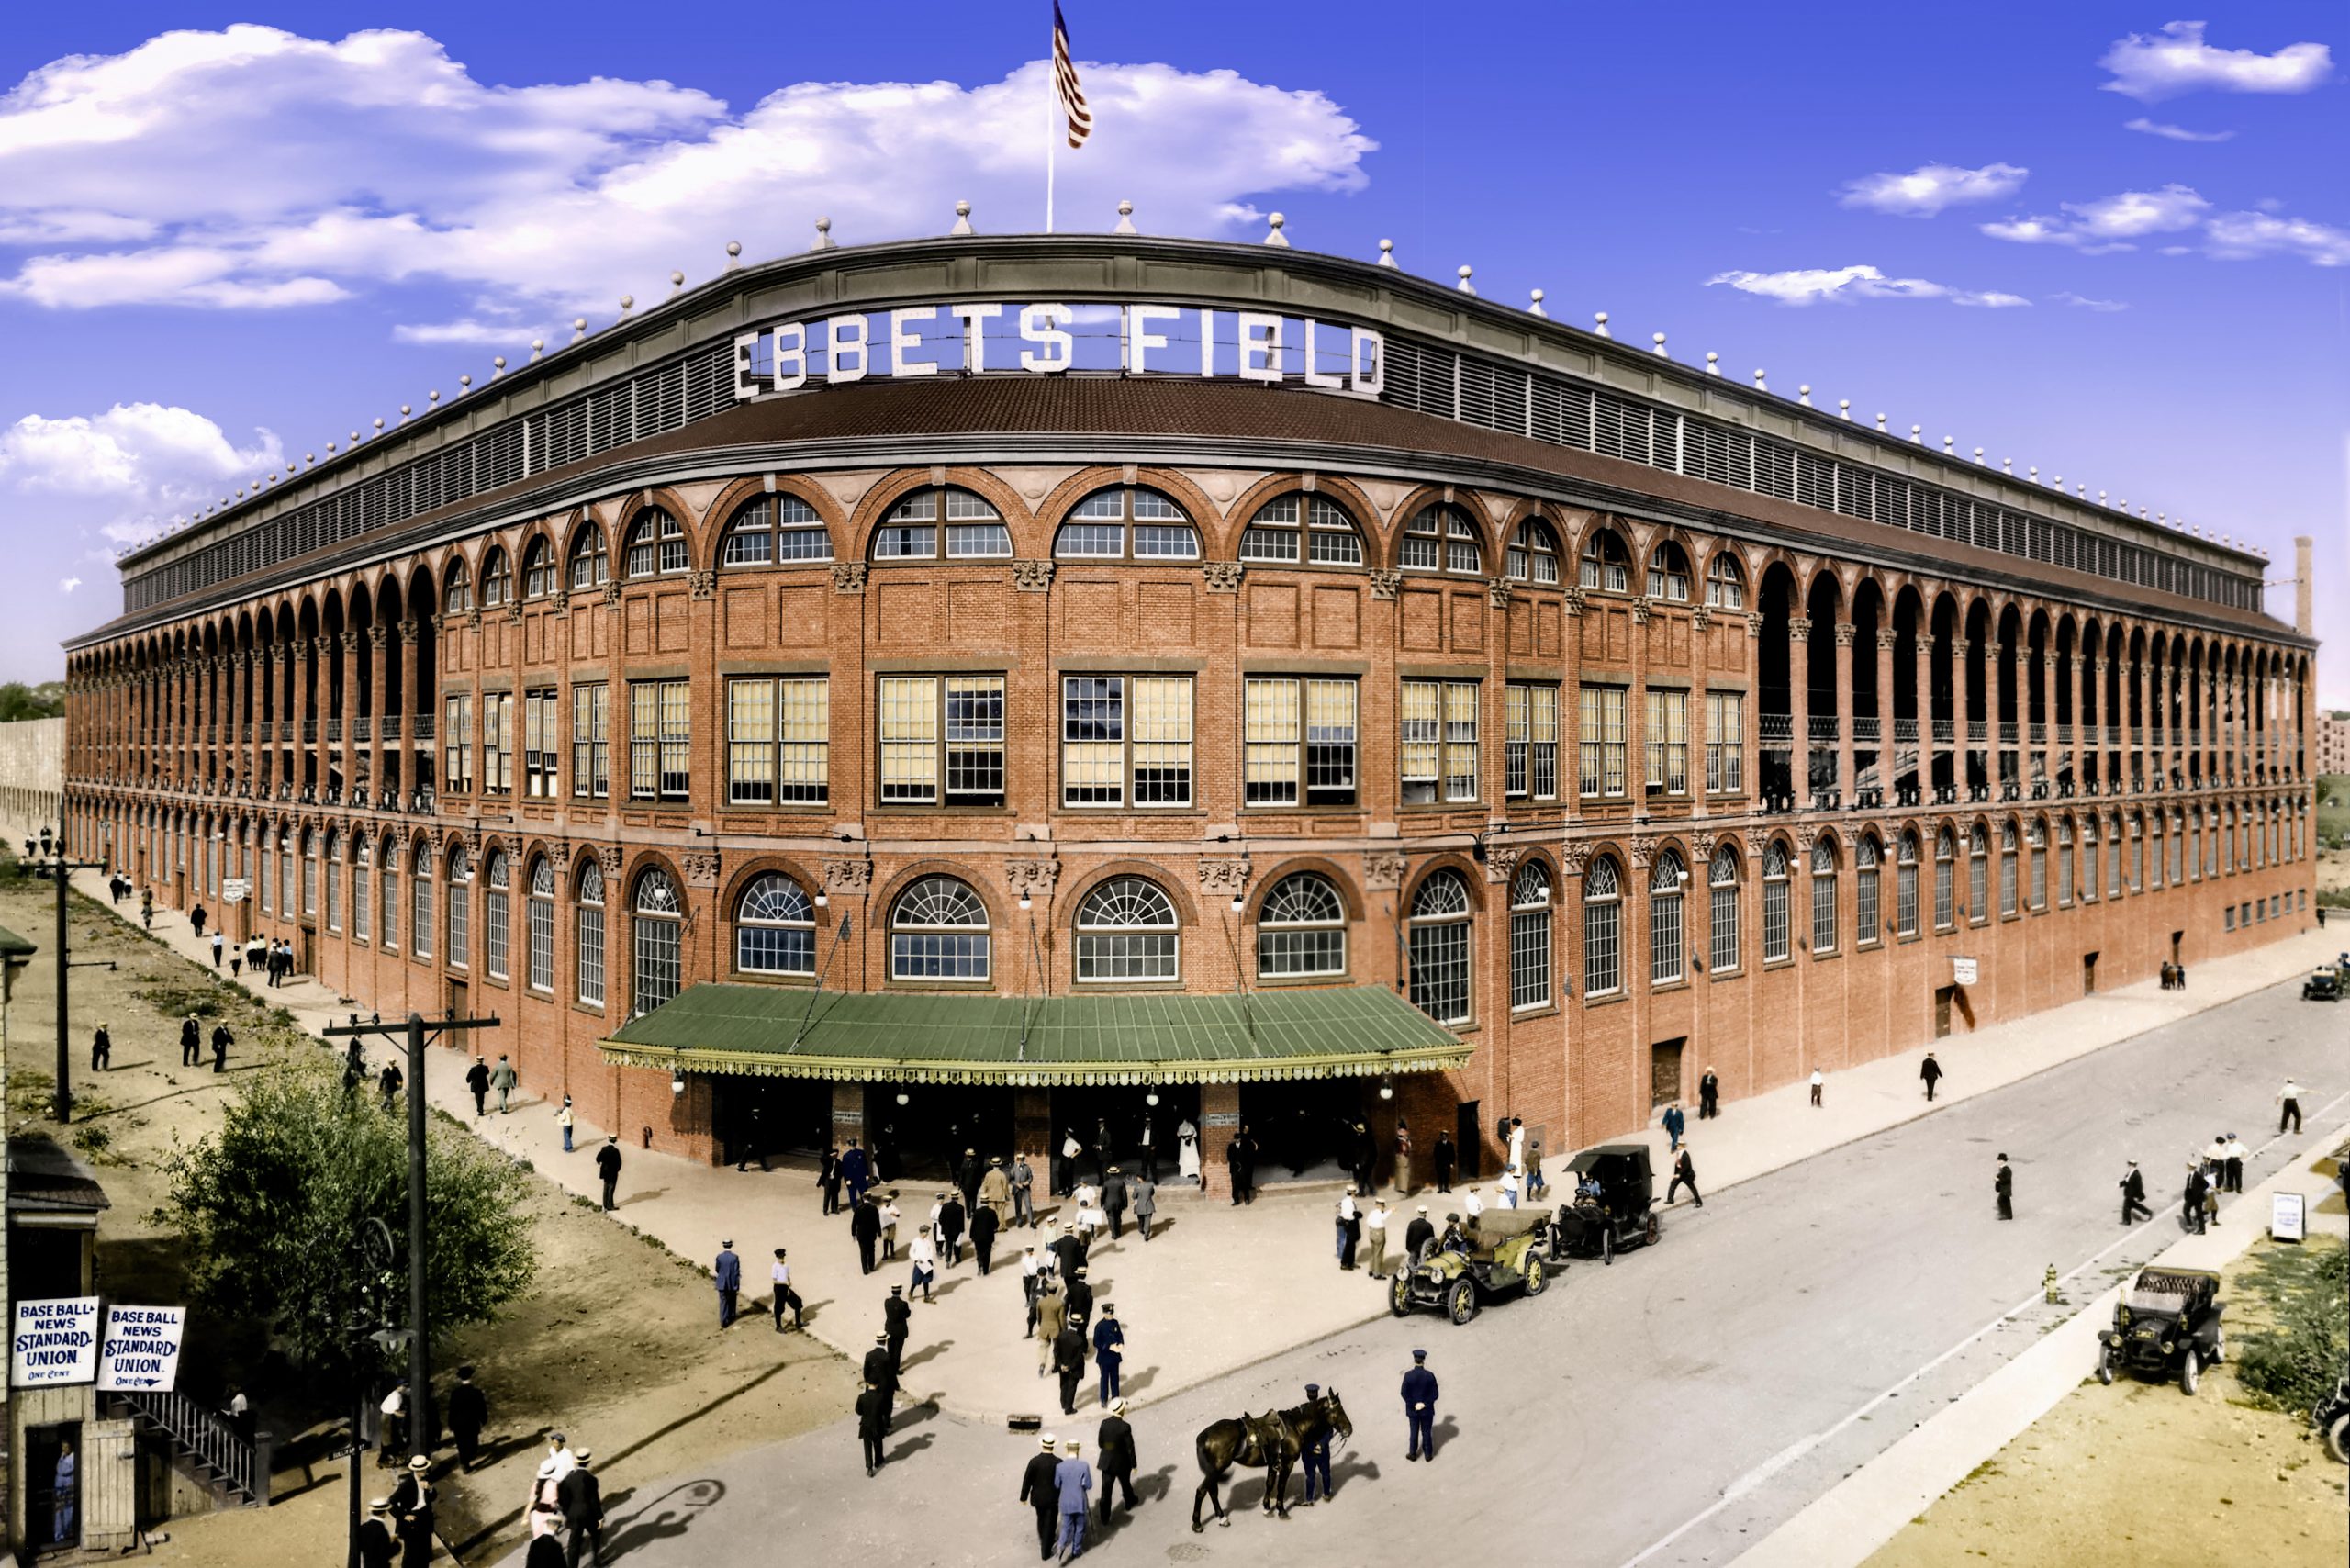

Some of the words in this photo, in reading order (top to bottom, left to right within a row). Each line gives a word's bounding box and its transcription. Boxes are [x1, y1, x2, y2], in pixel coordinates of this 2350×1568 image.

[733, 303, 1073, 400] EBBETS
[1130, 305, 1385, 395] FIELD
[20, 1305, 53, 1317] BASE
[56, 1304, 90, 1316] BALL
[111, 1311, 144, 1323] BASE
[146, 1312, 178, 1324] BALL
[34, 1318, 76, 1330] NEWS
[122, 1326, 162, 1337] NEWS
[17, 1331, 92, 1352] STANDARD
[105, 1339, 176, 1358] STANDARD
[26, 1350, 77, 1367] UNION
[114, 1358, 162, 1372] UNION
